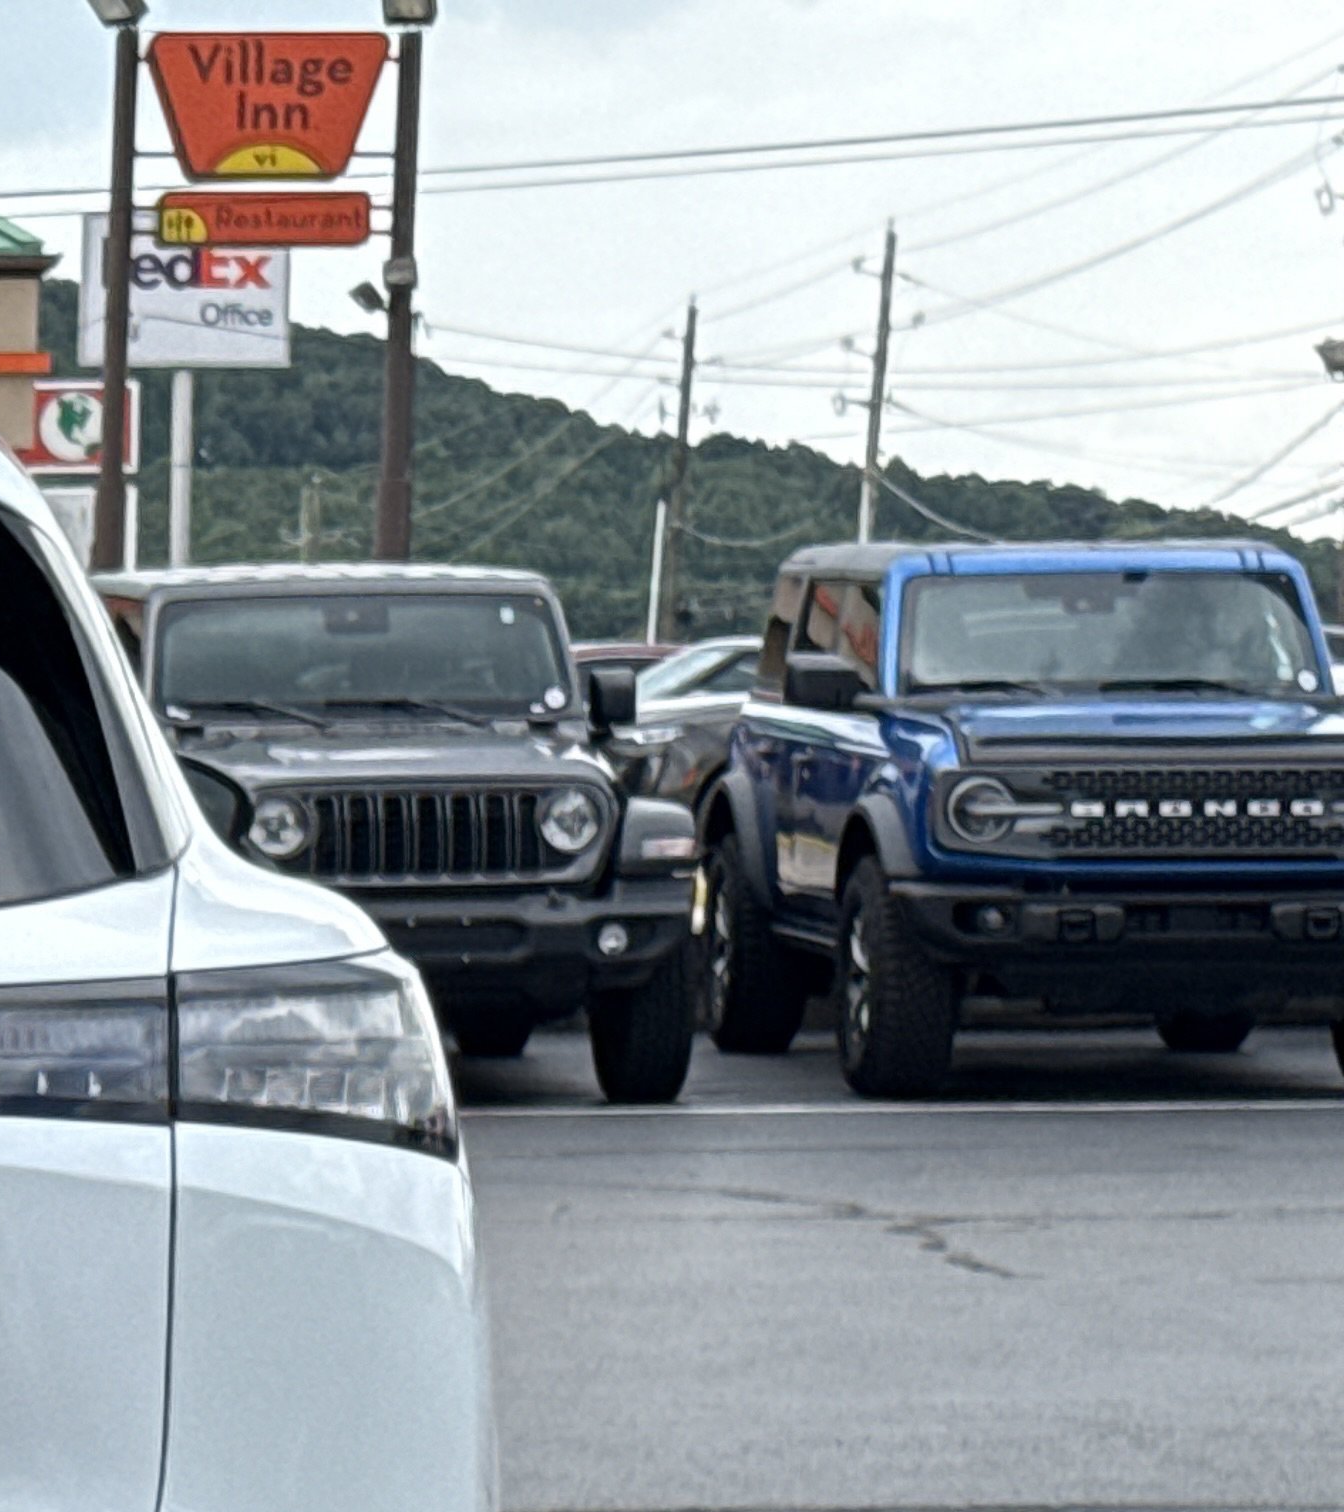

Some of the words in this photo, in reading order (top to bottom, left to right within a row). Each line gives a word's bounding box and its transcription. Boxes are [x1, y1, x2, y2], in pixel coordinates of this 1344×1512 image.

[188, 40, 353, 97] Village
[237, 90, 309, 130] Inn
[215, 205, 362, 231] Restaurant
[102, 246, 272, 290] edEx
[200, 302, 273, 327] Office
